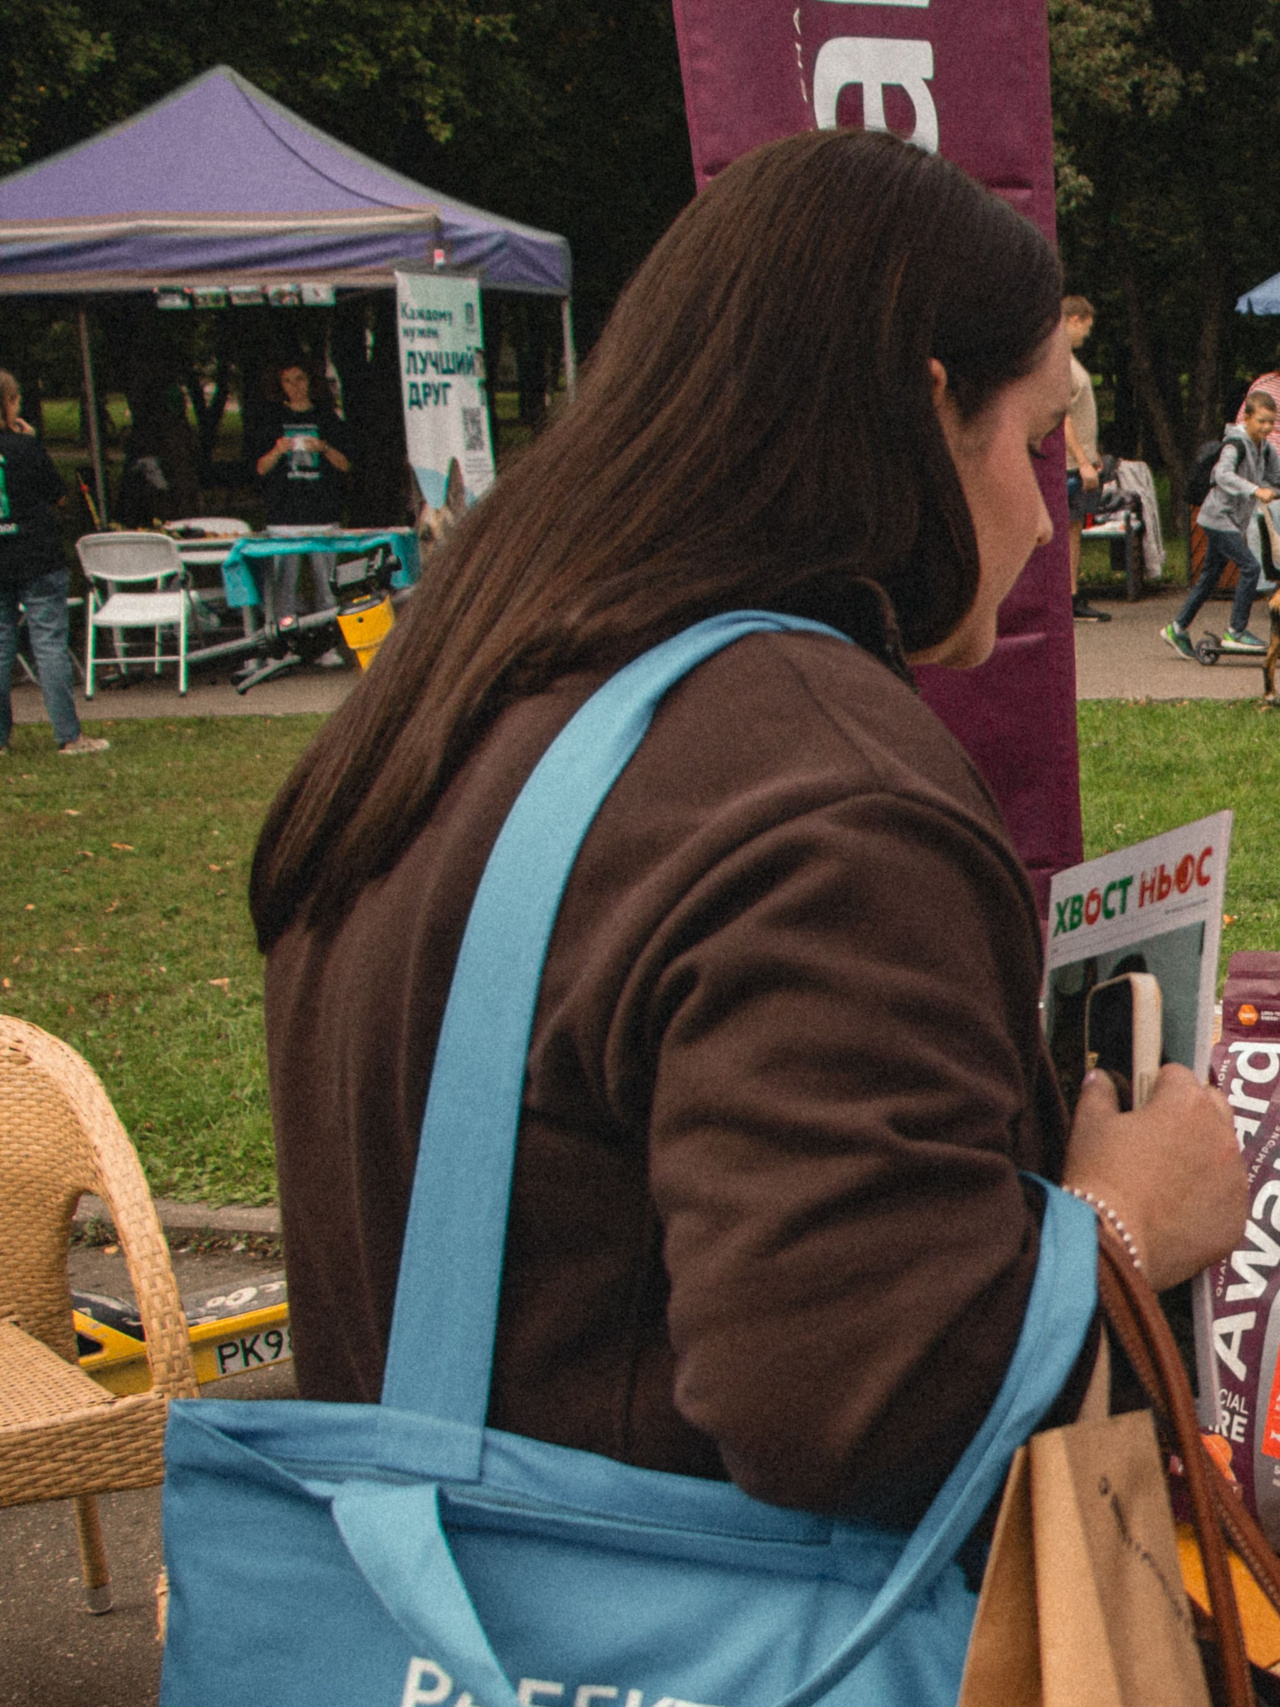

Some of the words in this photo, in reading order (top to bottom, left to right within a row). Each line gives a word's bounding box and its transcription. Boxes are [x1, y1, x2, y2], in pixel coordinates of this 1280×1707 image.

[401, 302, 453, 325] Каждому
[402, 326, 438, 343] нужен
[406, 345, 475, 375] ЛУЧШИЙ
[408, 381, 452, 411] ДРУГ
[1053, 875, 1134, 938] ХВОСТ
[216, 1328, 292, 1375] PK9
[1219, 1388, 1250, 1416] CIAL
